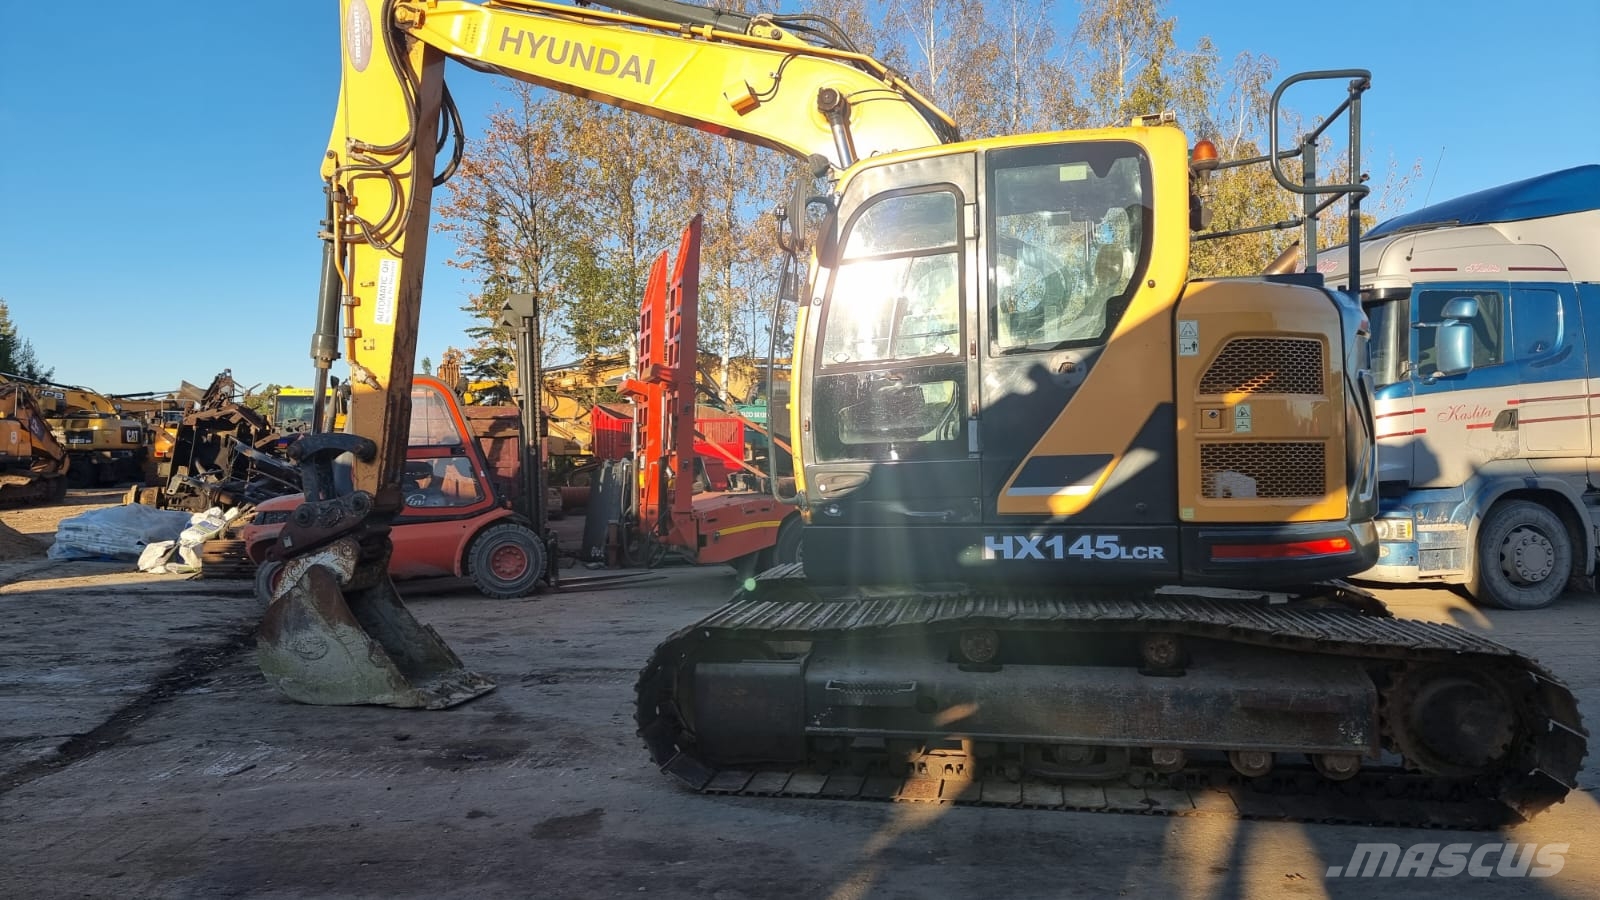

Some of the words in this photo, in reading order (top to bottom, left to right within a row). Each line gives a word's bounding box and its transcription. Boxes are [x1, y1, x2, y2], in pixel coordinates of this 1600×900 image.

[499, 26, 656, 85] HYUNDAI
[126, 430, 139, 442] CAT
[984, 535, 1165, 560] HX145LCR
